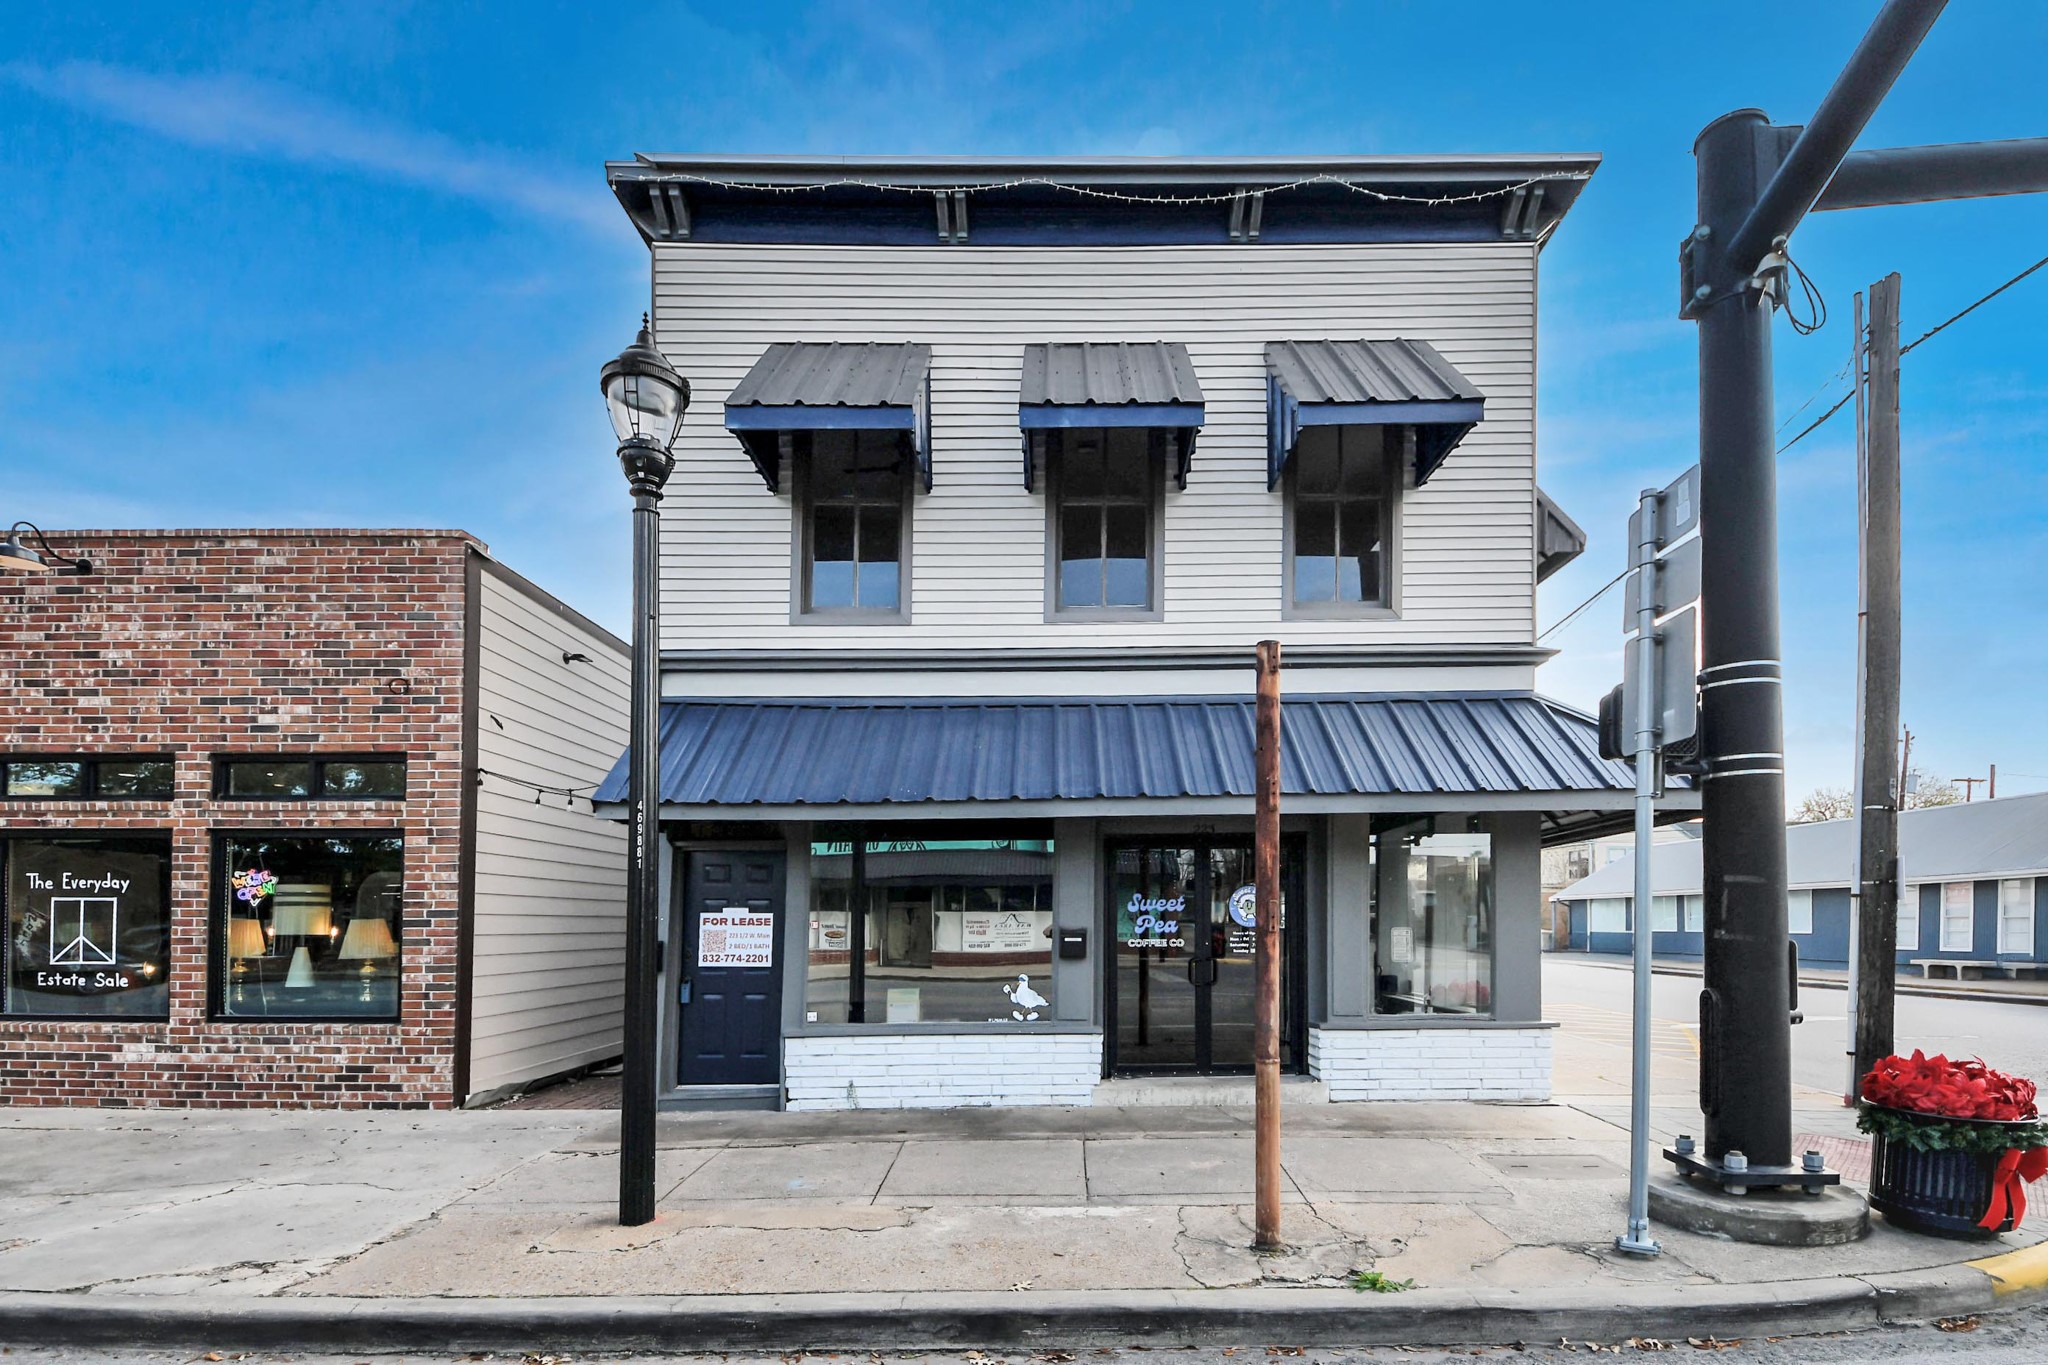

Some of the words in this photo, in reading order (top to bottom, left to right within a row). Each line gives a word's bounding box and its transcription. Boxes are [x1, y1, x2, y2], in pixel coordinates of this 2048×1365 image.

[25, 872, 54, 890] The
[62, 872, 130, 894] Everyday
[1127, 893, 1186, 912] Sweet
[1135, 914, 1179, 934] Pea
[1127, 938, 1168, 948] COFFEE
[1169, 938, 1185, 948] CO
[37, 972, 86, 986] Estate
[94, 972, 129, 987] Sale
